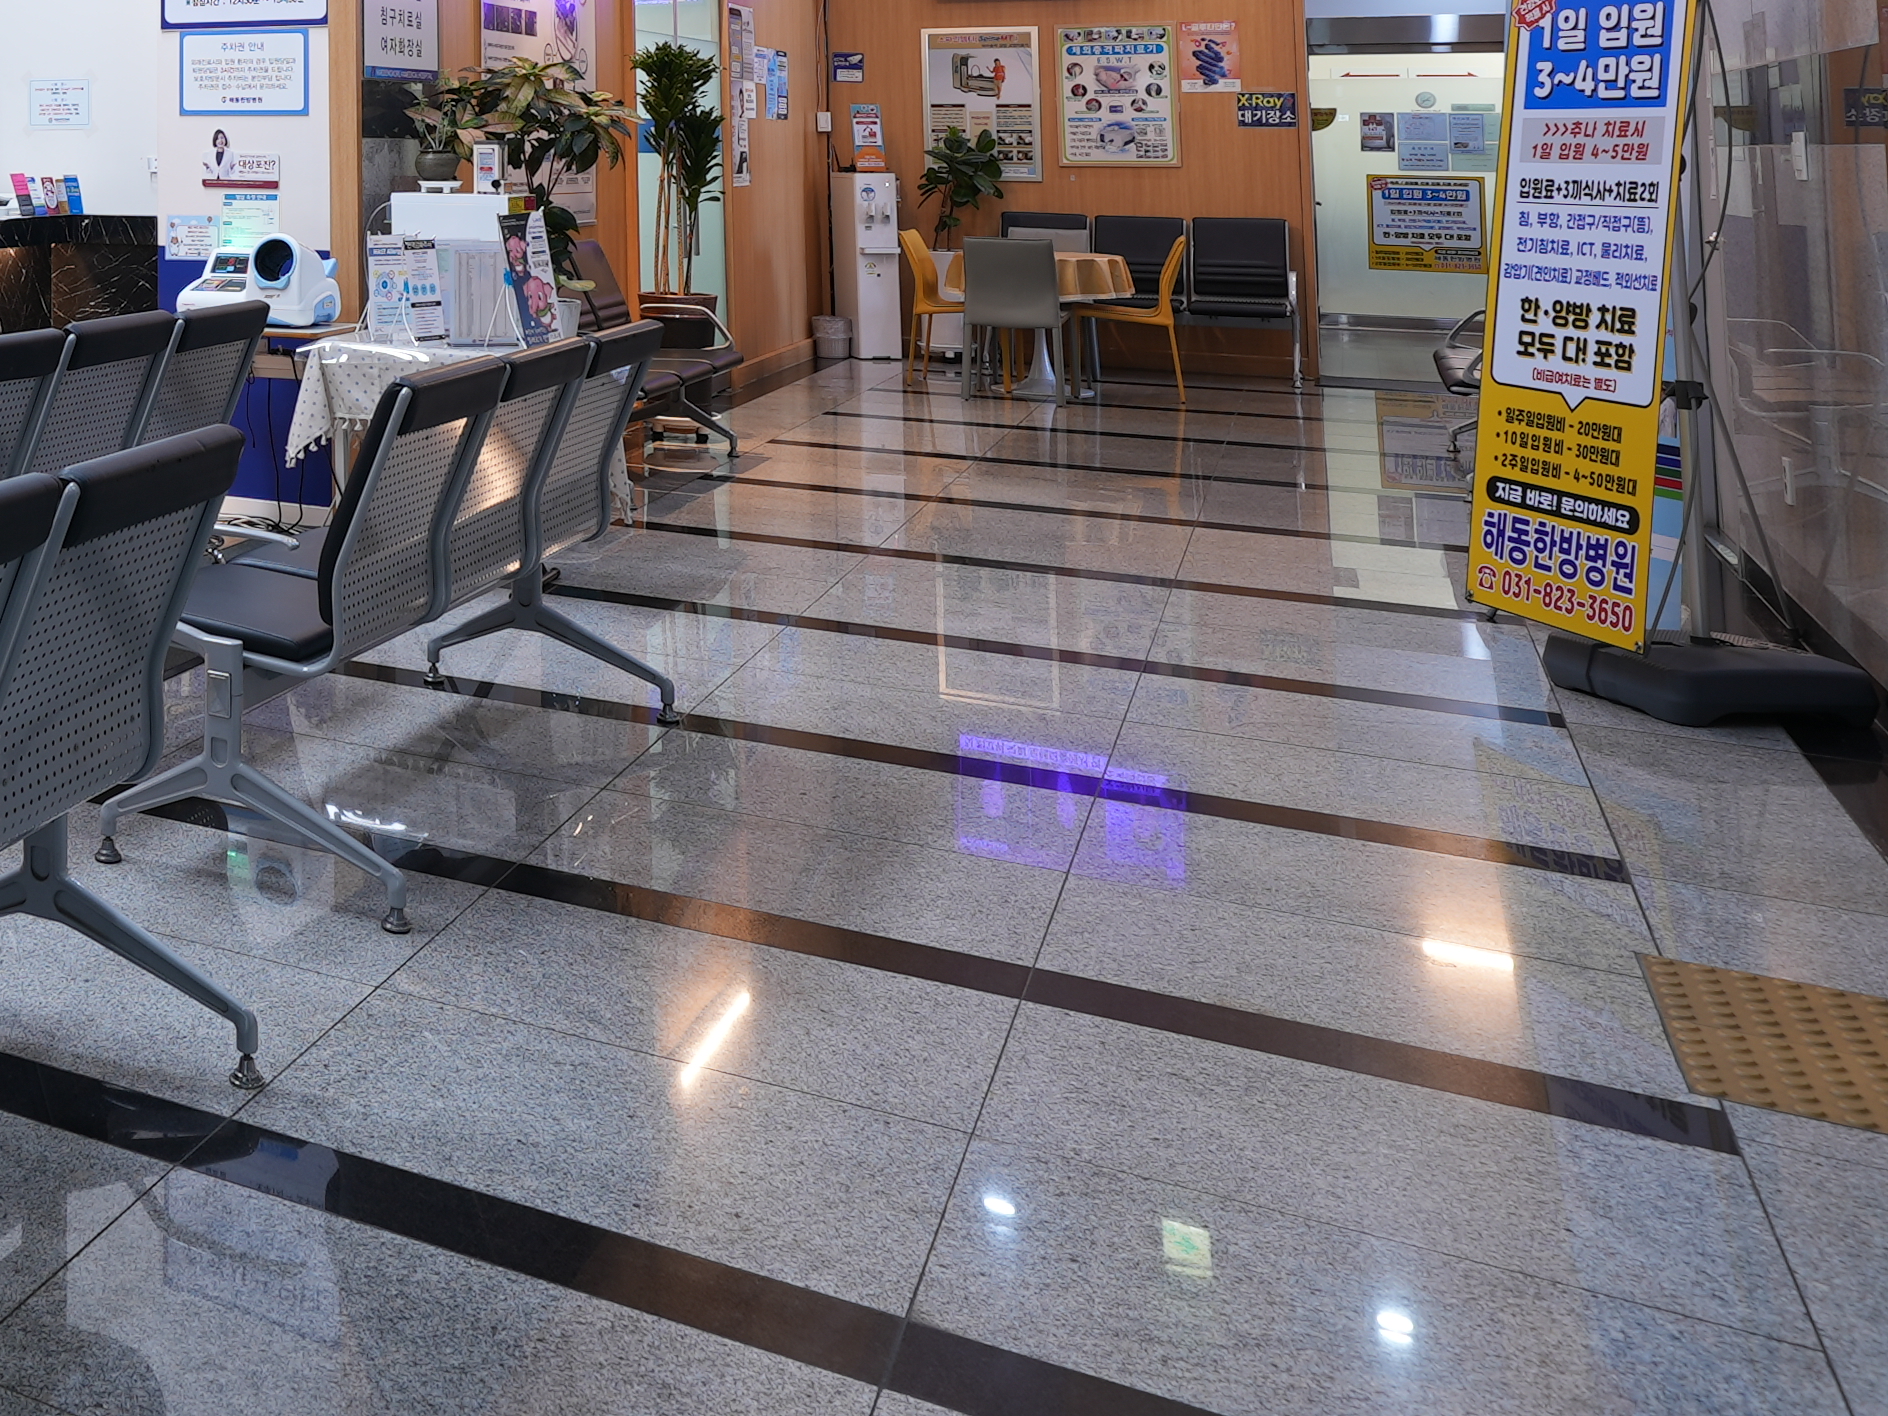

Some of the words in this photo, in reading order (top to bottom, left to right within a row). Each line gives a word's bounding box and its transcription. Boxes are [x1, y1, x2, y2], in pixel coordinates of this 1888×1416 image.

[380, 6, 422, 30] 침구치료실
[1534, 6, 1588, 51] 1일
[1598, 0, 1666, 51] 입원
[221, 42, 244, 52] 주차권
[248, 42, 265, 51] 안내
[380, 35, 422, 58] 여자화장실
[1072, 45, 1157, 55] 체외충격파치료기
[1532, 52, 1663, 101] 3~4만원
[1237, 94, 1284, 109] X-Ray
[1238, 110, 1297, 124] 대기장소
[1602, 120, 1647, 139] 치료시
[1531, 142, 1554, 161] 1일
[1558, 142, 1586, 161] 입원
[1590, 142, 1650, 161] 4~5만원
[238, 160, 276, 170] 대상포진?
[1595, 304, 1637, 336] 치료
[1516, 330, 1556, 361] 모두
[1561, 335, 1588, 366] 다!
[1592, 340, 1635, 372] 포함
[1577, 421, 1623, 444] 20만원대
[1503, 430, 1564, 456] 10일입원비
[1575, 443, 1621, 467] 30만원대
[1501, 453, 1561, 480] 2주일입원비
[1494, 482, 1523, 503] 지금
[1525, 489, 1558, 511] 바로!
[1560, 497, 1631, 529] 문의하세요
[1481, 508, 1638, 598] 해동한방병원
[1500, 569, 1635, 635] 031-823-3650
